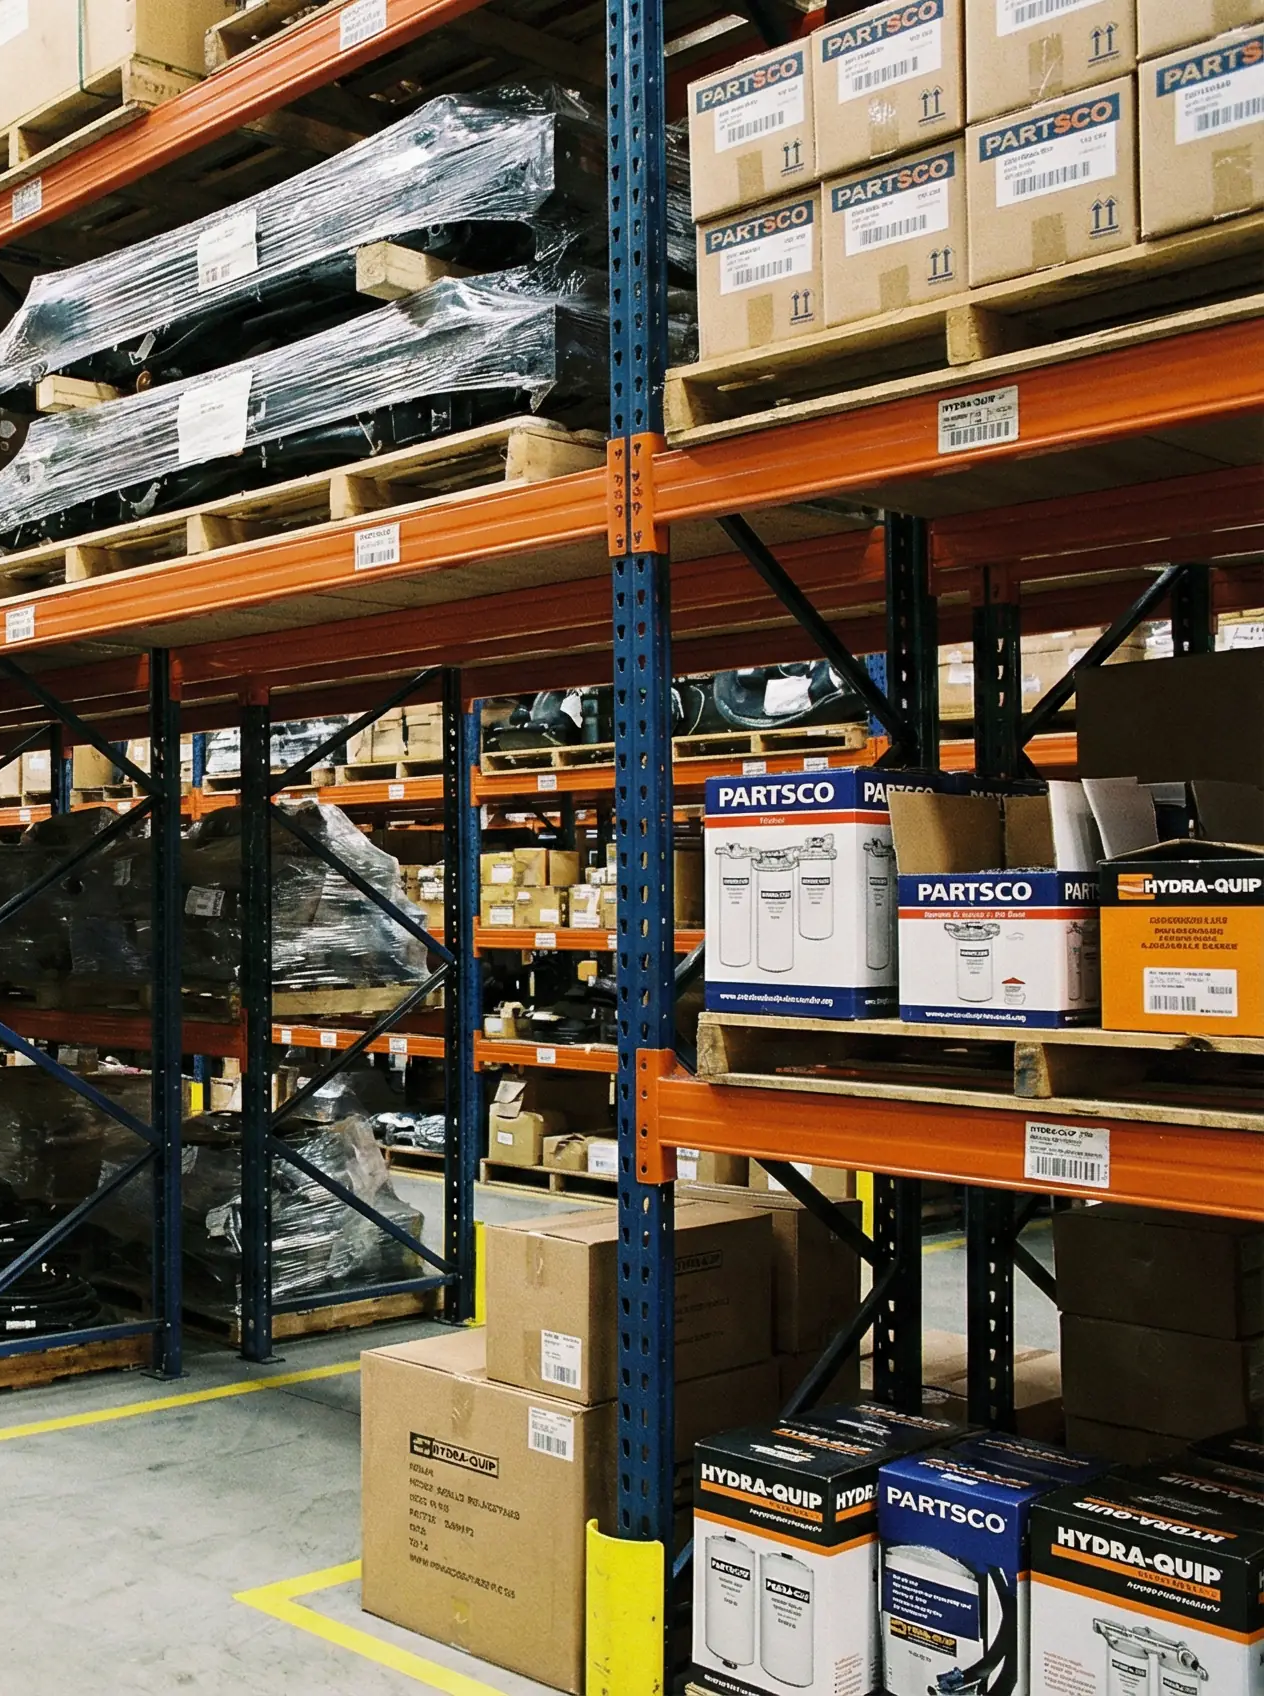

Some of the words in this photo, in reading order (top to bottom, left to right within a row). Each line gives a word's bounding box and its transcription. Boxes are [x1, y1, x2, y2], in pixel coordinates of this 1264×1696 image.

[827, 2, 937, 57] PARTSCO
[700, 58, 798, 109] PARTSCO
[985, 101, 1112, 156] PARTSCO
[836, 158, 949, 208] PARTSCO
[710, 206, 808, 249] PARTSCO
[719, 782, 834, 807] PARTSCO
[918, 882, 1032, 901] PARTSCO
[1144, 878, 1262, 893] HYDRA-QUIP
[701, 1463, 823, 1510] HYDRA-QUIP
[887, 1486, 1006, 1534] PARTSCO
[1073, 1501, 1226, 1544] HYDRA-QUIP
[1058, 1526, 1223, 1585] HYDRA-QUIP
